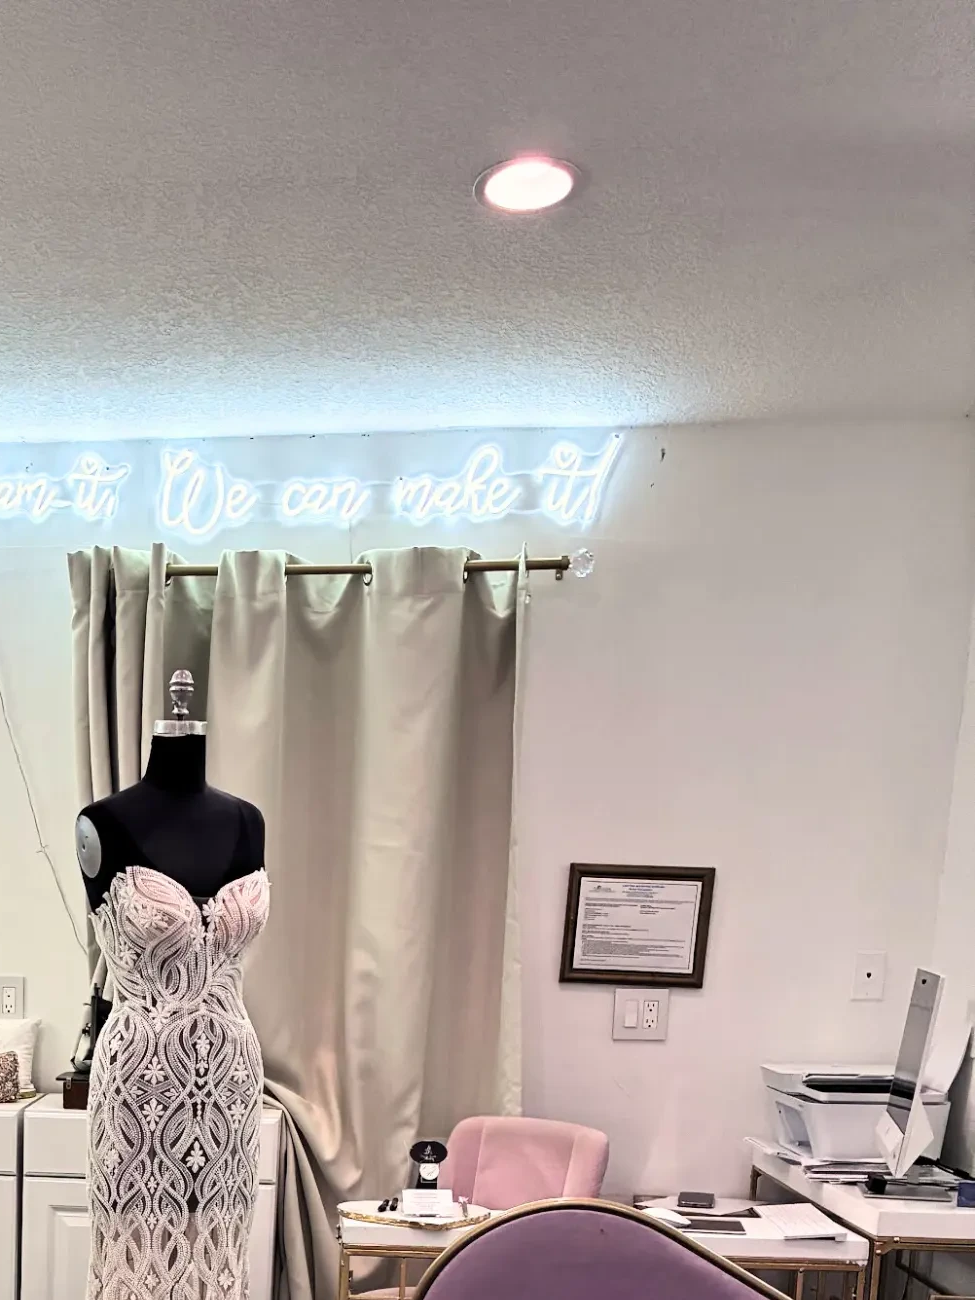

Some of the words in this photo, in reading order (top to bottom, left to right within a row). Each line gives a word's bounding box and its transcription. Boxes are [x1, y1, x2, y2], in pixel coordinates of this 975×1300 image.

[164, 450, 255, 534] We
[282, 479, 367, 519] can
[398, 446, 522, 518] make
